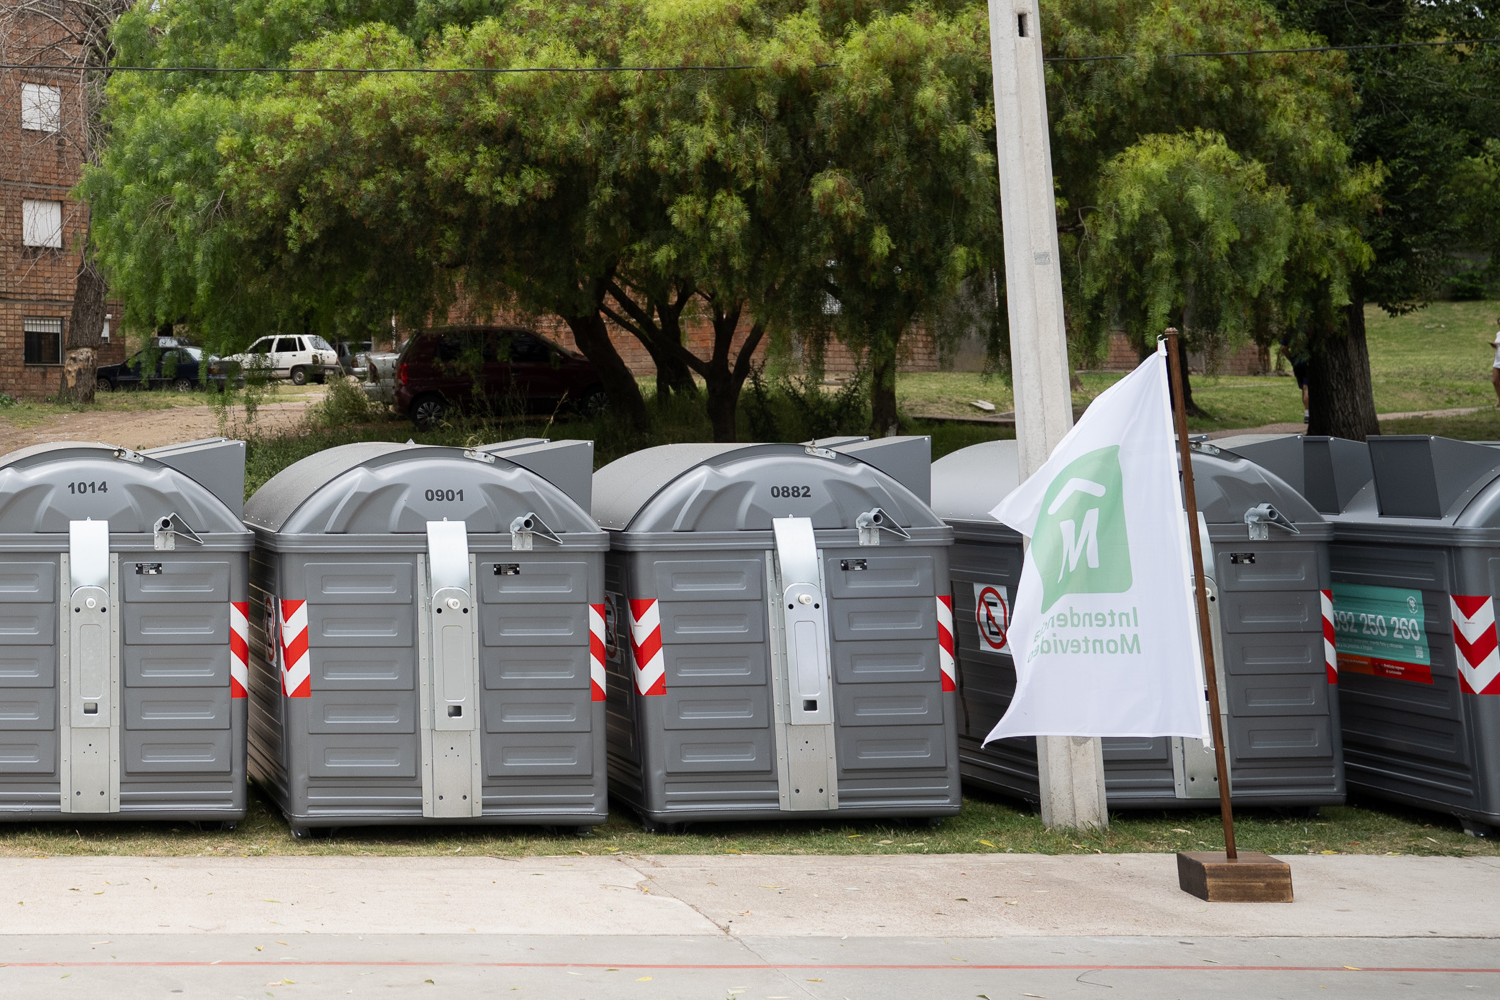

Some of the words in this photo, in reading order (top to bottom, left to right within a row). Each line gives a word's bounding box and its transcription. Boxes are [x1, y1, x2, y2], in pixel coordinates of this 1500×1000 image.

[67, 481, 108, 495] 1014
[770, 485, 812, 498] 0882
[424, 489, 464, 502] 0901
[1359, 613, 1388, 637] 250
[1390, 616, 1421, 641] 260
